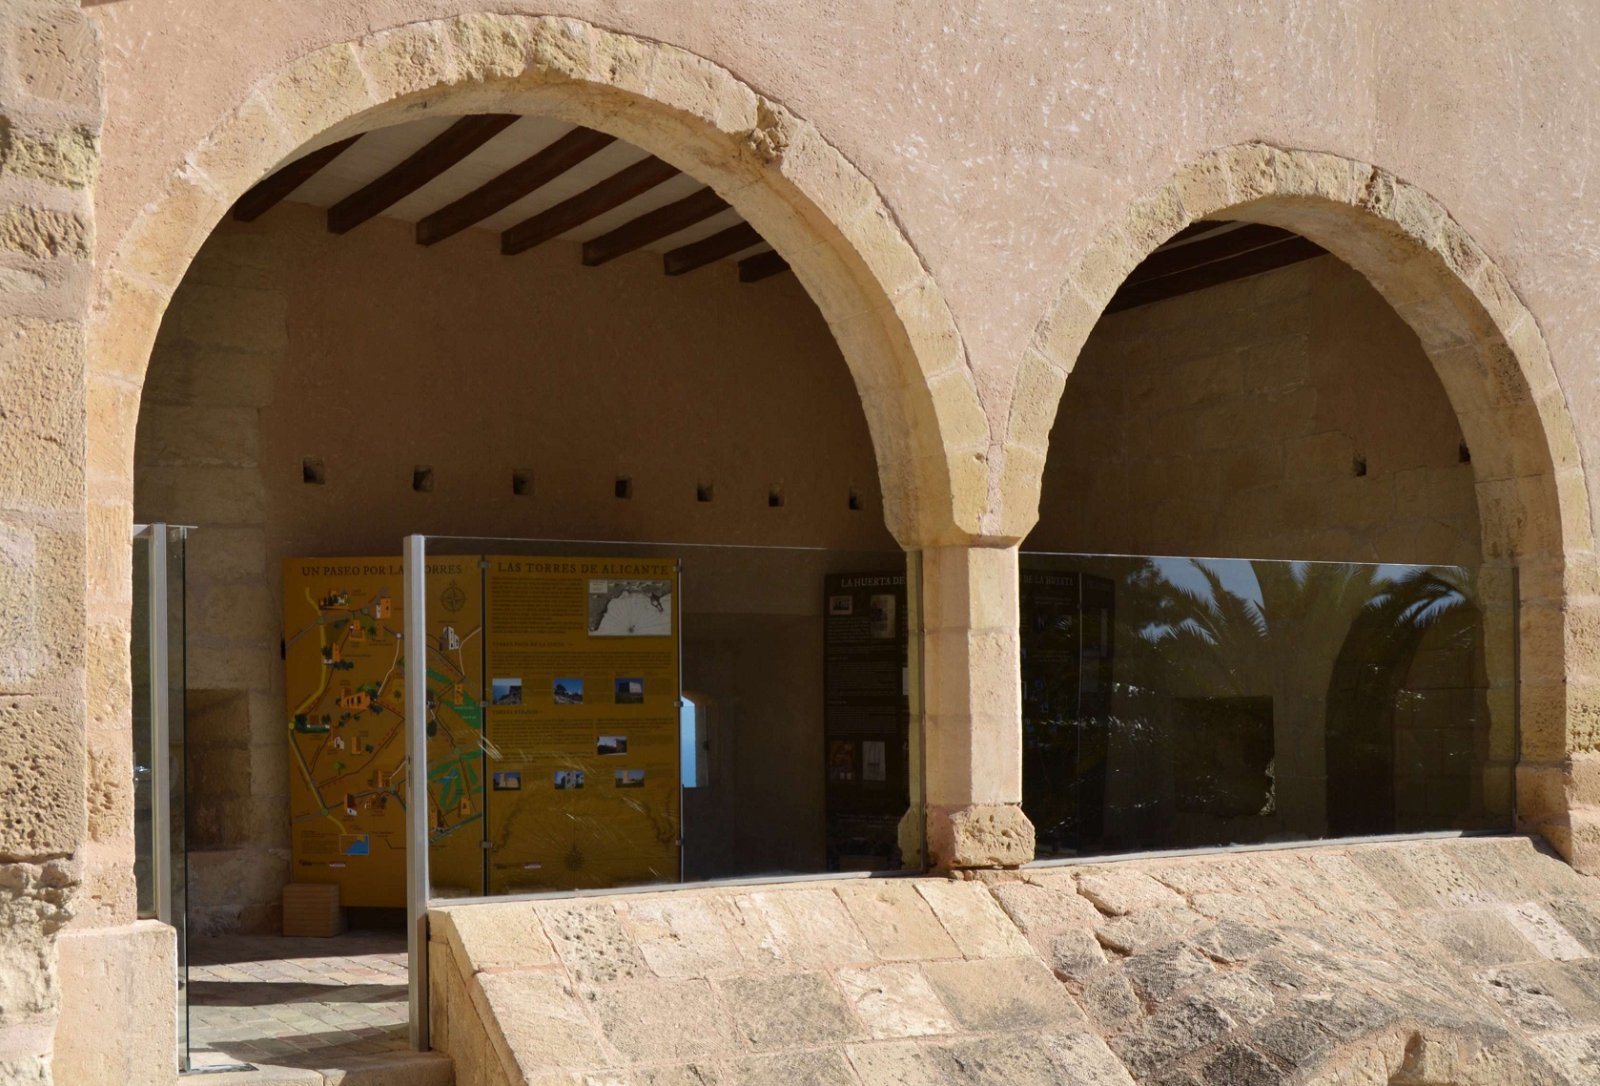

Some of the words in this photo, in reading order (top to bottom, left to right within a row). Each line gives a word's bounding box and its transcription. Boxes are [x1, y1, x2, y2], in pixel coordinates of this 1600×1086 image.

[301, 566, 320, 577] UN
[323, 566, 361, 576] PASEO
[363, 565, 386, 576] POR
[389, 565, 404, 575] LA
[425, 564, 463, 575] ORRES
[498, 562, 521, 573] LAS
[525, 562, 577, 574] TORRES
[581, 563, 598, 574] DE
[602, 563, 669, 575] ALICANTE
[841, 577, 853, 588] LA
[854, 576, 891, 587] HUERTA
[892, 575, 906, 585] DE
